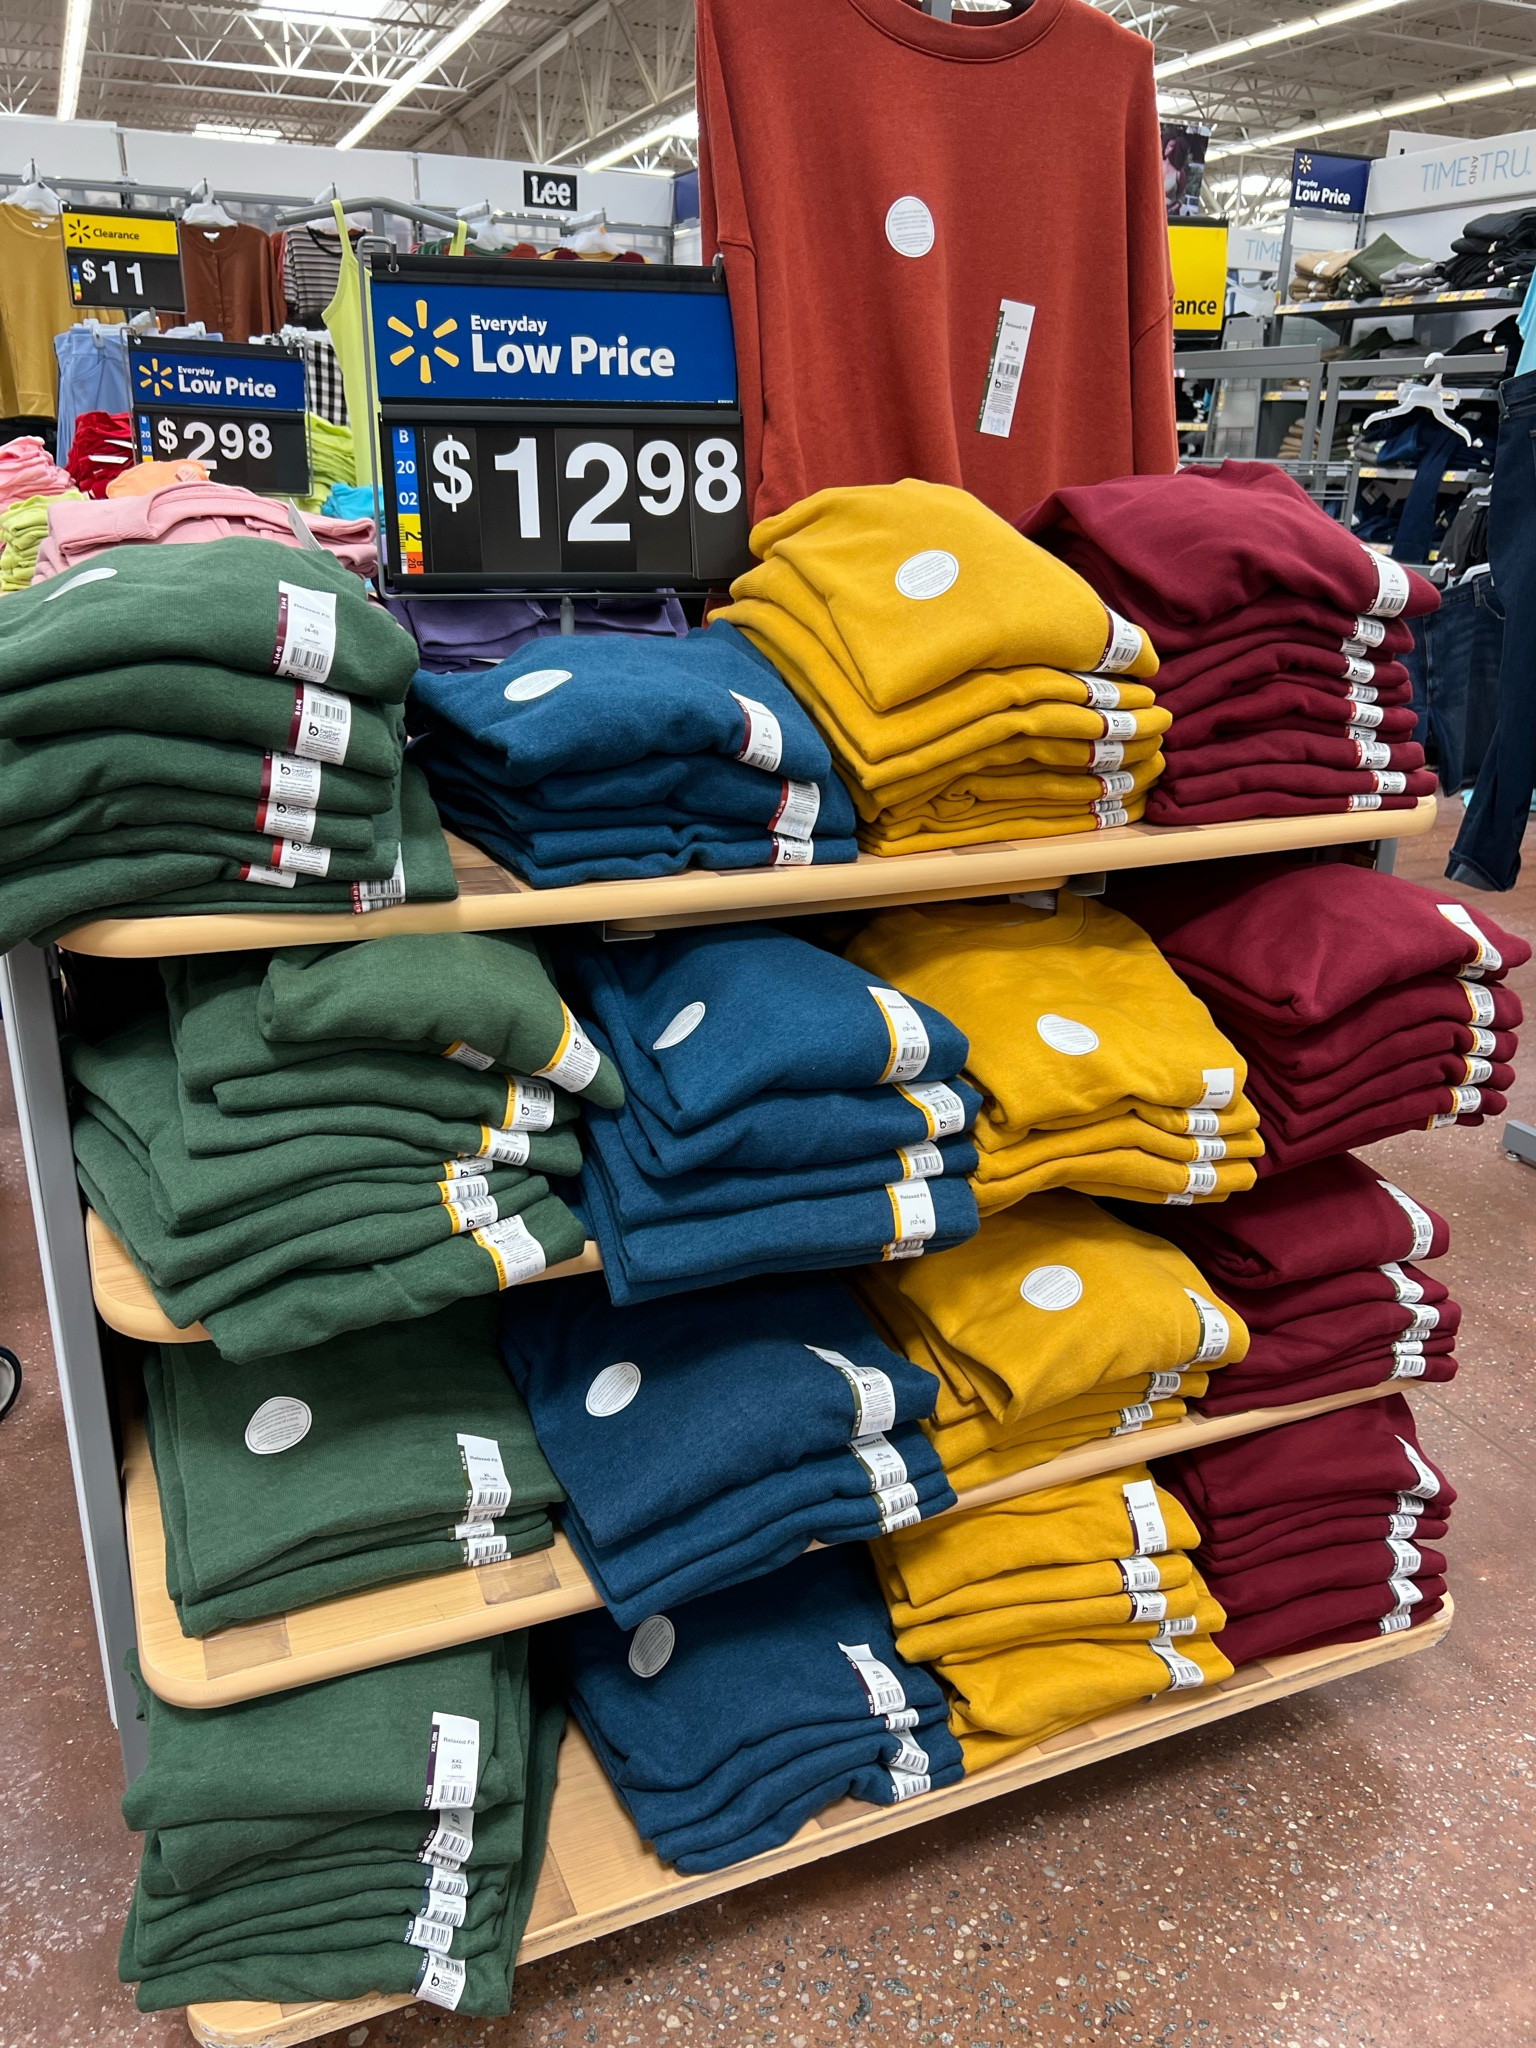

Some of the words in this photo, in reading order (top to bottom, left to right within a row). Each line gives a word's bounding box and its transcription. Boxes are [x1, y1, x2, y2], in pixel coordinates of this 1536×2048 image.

[1422, 156, 1470, 192] TIME
[1480, 146, 1529, 182] TRU
[530, 176, 571, 206] Lee
[1298, 179, 1318, 188] Everyday
[1296, 186, 1320, 202] Low
[1321, 188, 1350, 205] Price
[93, 228, 140, 242] Clearance
[471, 314, 547, 335] Everyday
[472, 334, 561, 374] Low
[570, 335, 675, 376] Price
[178, 366, 214, 377] Everyday
[178, 374, 221, 394] Low
[225, 377, 276, 398] Price
[399, 430, 409, 443] B
[396, 461, 416, 474] 20
[398, 492, 418, 505] 02
